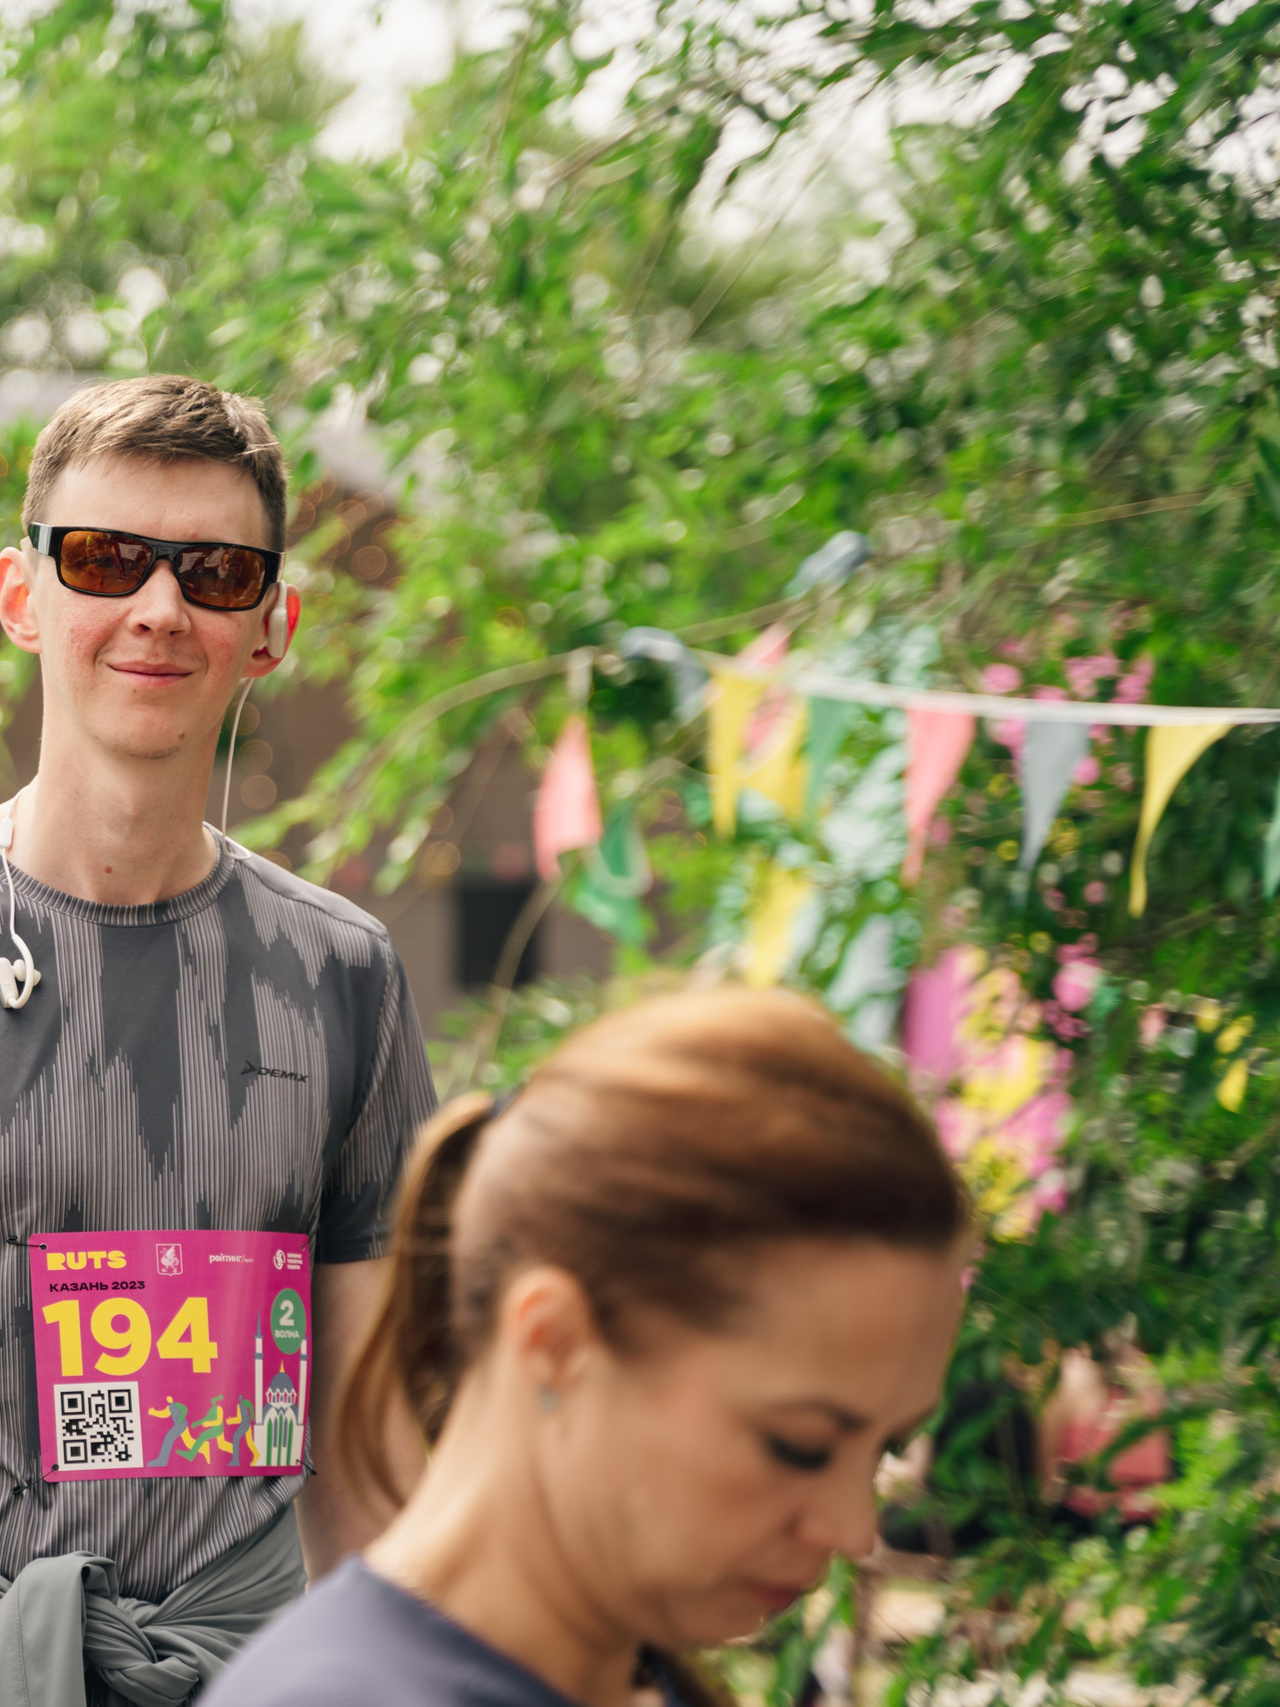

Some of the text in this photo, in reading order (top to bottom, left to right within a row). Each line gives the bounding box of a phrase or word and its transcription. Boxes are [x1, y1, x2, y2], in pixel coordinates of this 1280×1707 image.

[257, 1067, 309, 1083] DEMIX
[47, 1250, 127, 1271] RUTS
[49, 1281, 146, 1292] КАЗАНЬ 2023
[279, 1300, 295, 1326] 2
[42, 1297, 218, 1376] 194
[275, 1330, 300, 1340] ВОЛНА
